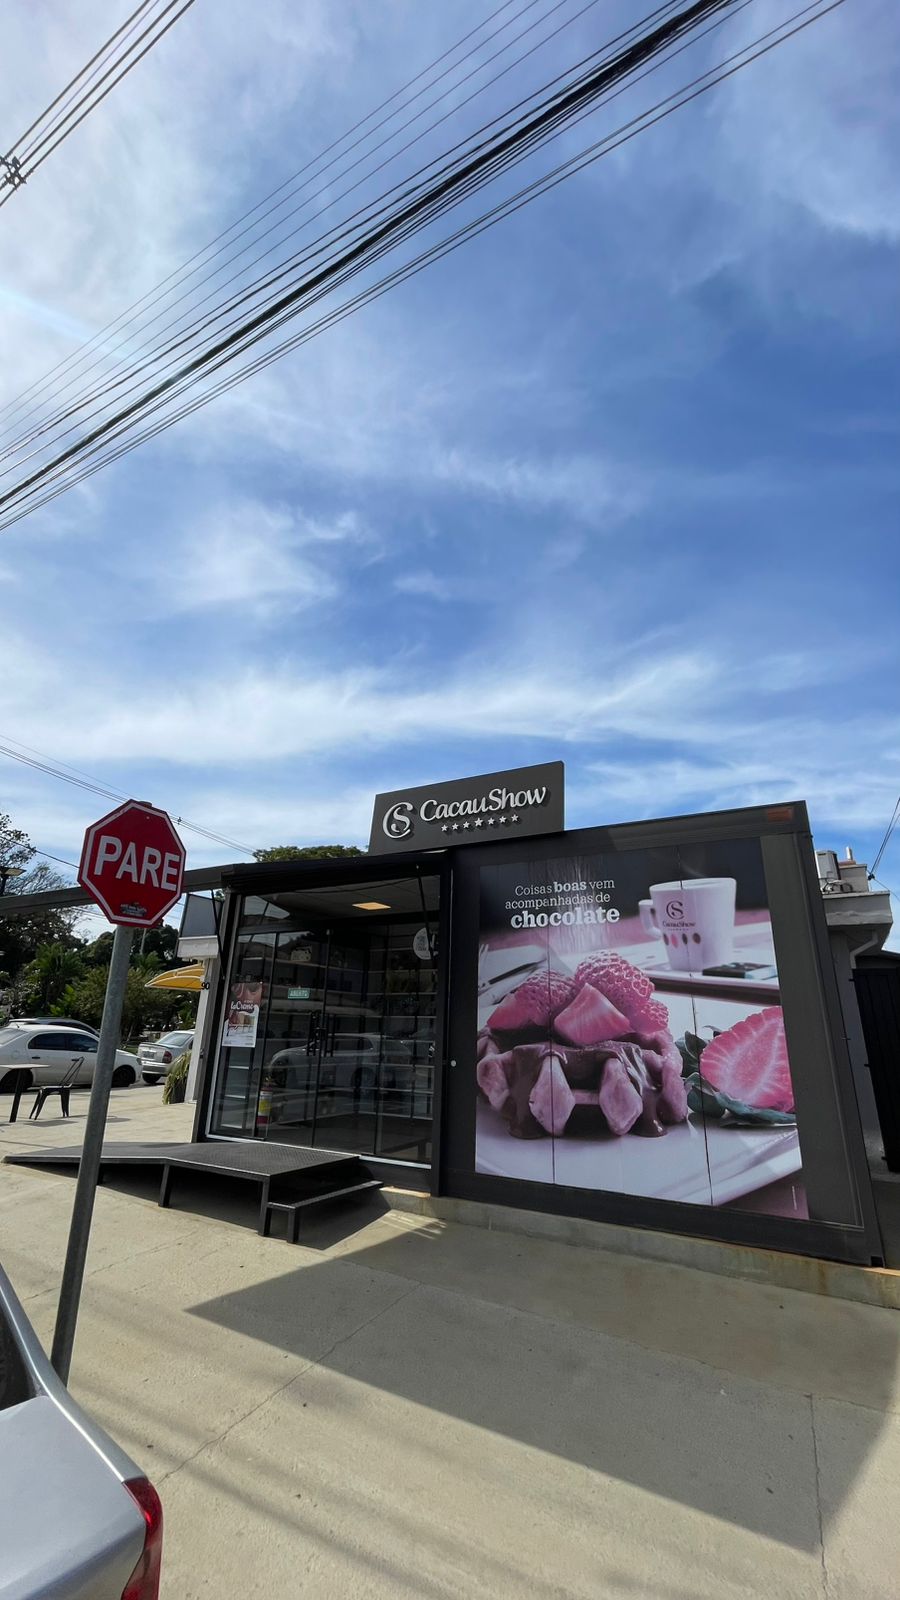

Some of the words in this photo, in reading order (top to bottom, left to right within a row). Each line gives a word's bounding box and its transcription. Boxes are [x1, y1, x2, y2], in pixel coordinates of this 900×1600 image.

[419, 786, 546, 822] CacauShow
[93, 835, 180, 891] PARE
[515, 885, 552, 896] Coisas
[553, 881, 587, 893] boas
[588, 879, 615, 889] vem
[505, 894, 594, 910] acompanhadas
[595, 892, 611, 903] de
[510, 906, 620, 929] chocolate
